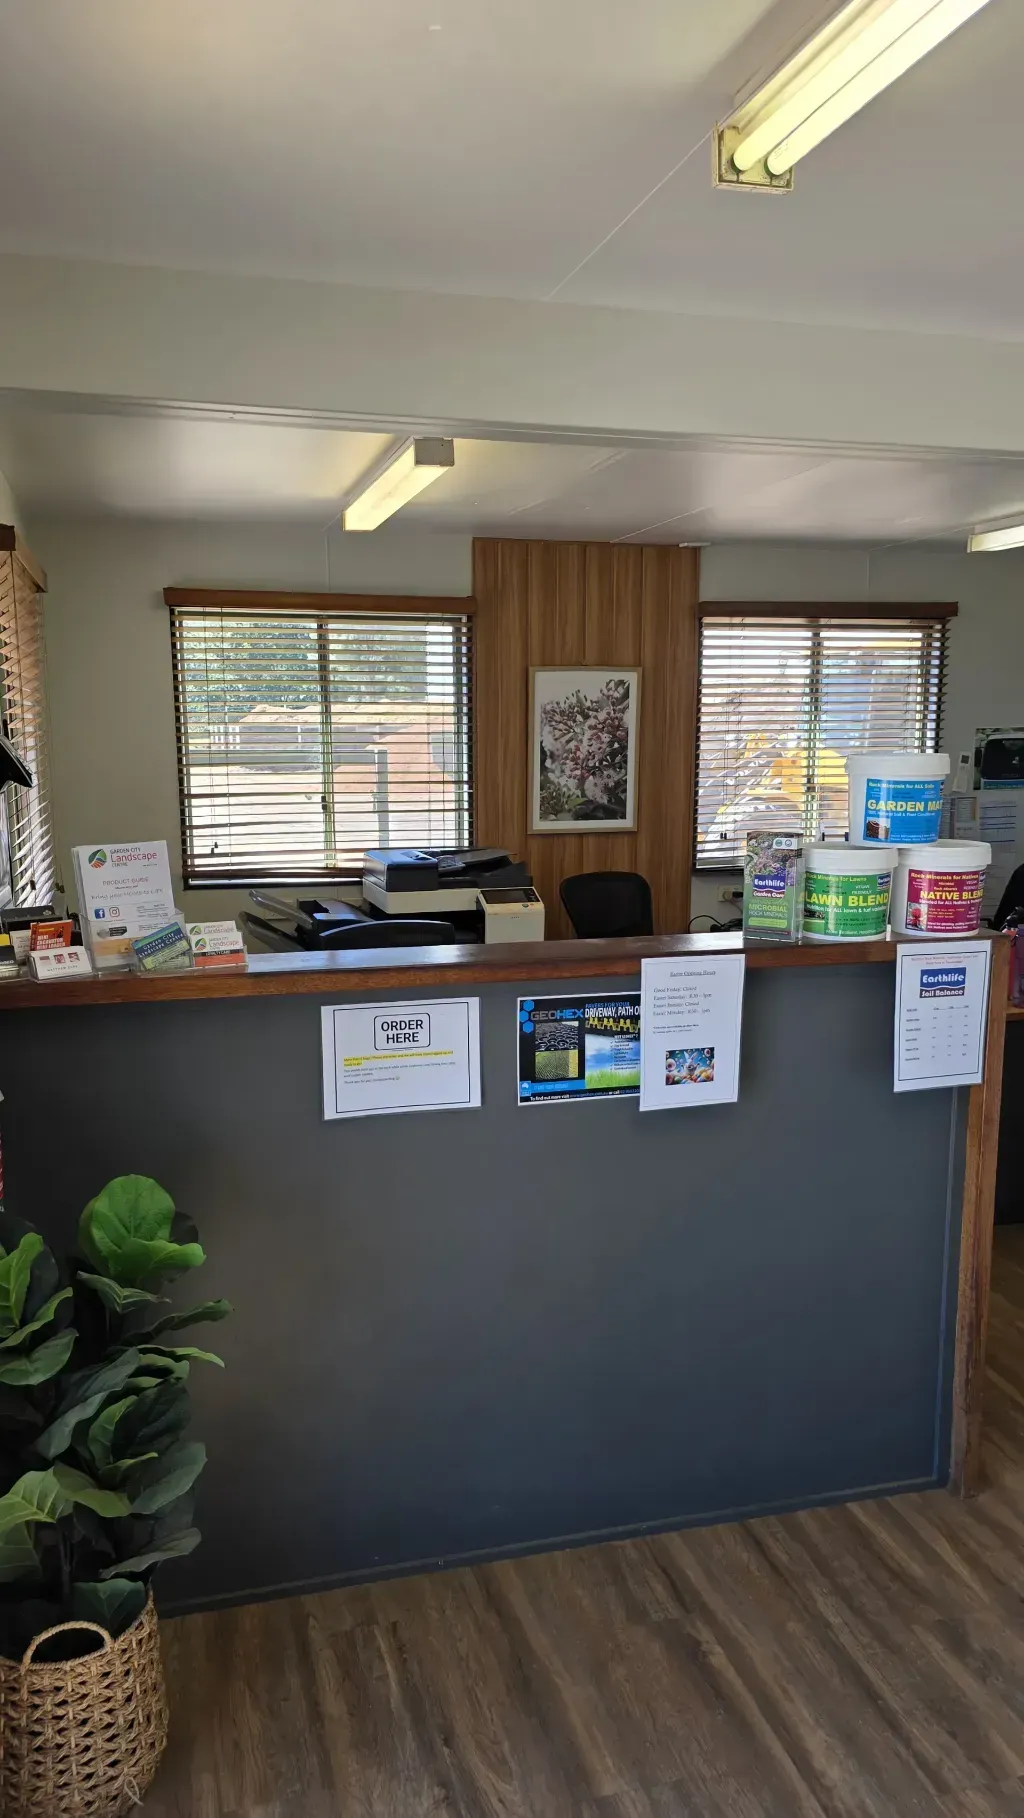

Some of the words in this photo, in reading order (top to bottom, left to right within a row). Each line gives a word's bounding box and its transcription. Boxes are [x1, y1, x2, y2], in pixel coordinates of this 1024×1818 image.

[867, 800, 924, 812] GARDEN
[110, 852, 158, 863] Landscape
[102, 878, 130, 886] PRODUCT
[754, 878, 784, 887] Earthlife
[805, 892, 842, 906] LAWN
[848, 893, 888, 906] BLEND
[920, 890, 960, 900] NATIVE
[748, 904, 787, 912] MICROBIAL
[143, 938, 162, 950] Garden
[163, 932, 174, 940] City
[166, 933, 184, 945] Centre
[209, 940, 240, 948] Landscape
[922, 973, 964, 983] Earthlife
[530, 1008, 584, 1021] GEOHEX
[585, 1006, 617, 1018] DRIVEWAY,
[618, 1006, 634, 1016] PATH
[634, 1006, 641, 1015] O
[380, 1019, 424, 1032] ORDER
[386, 1032, 420, 1044] HERE
